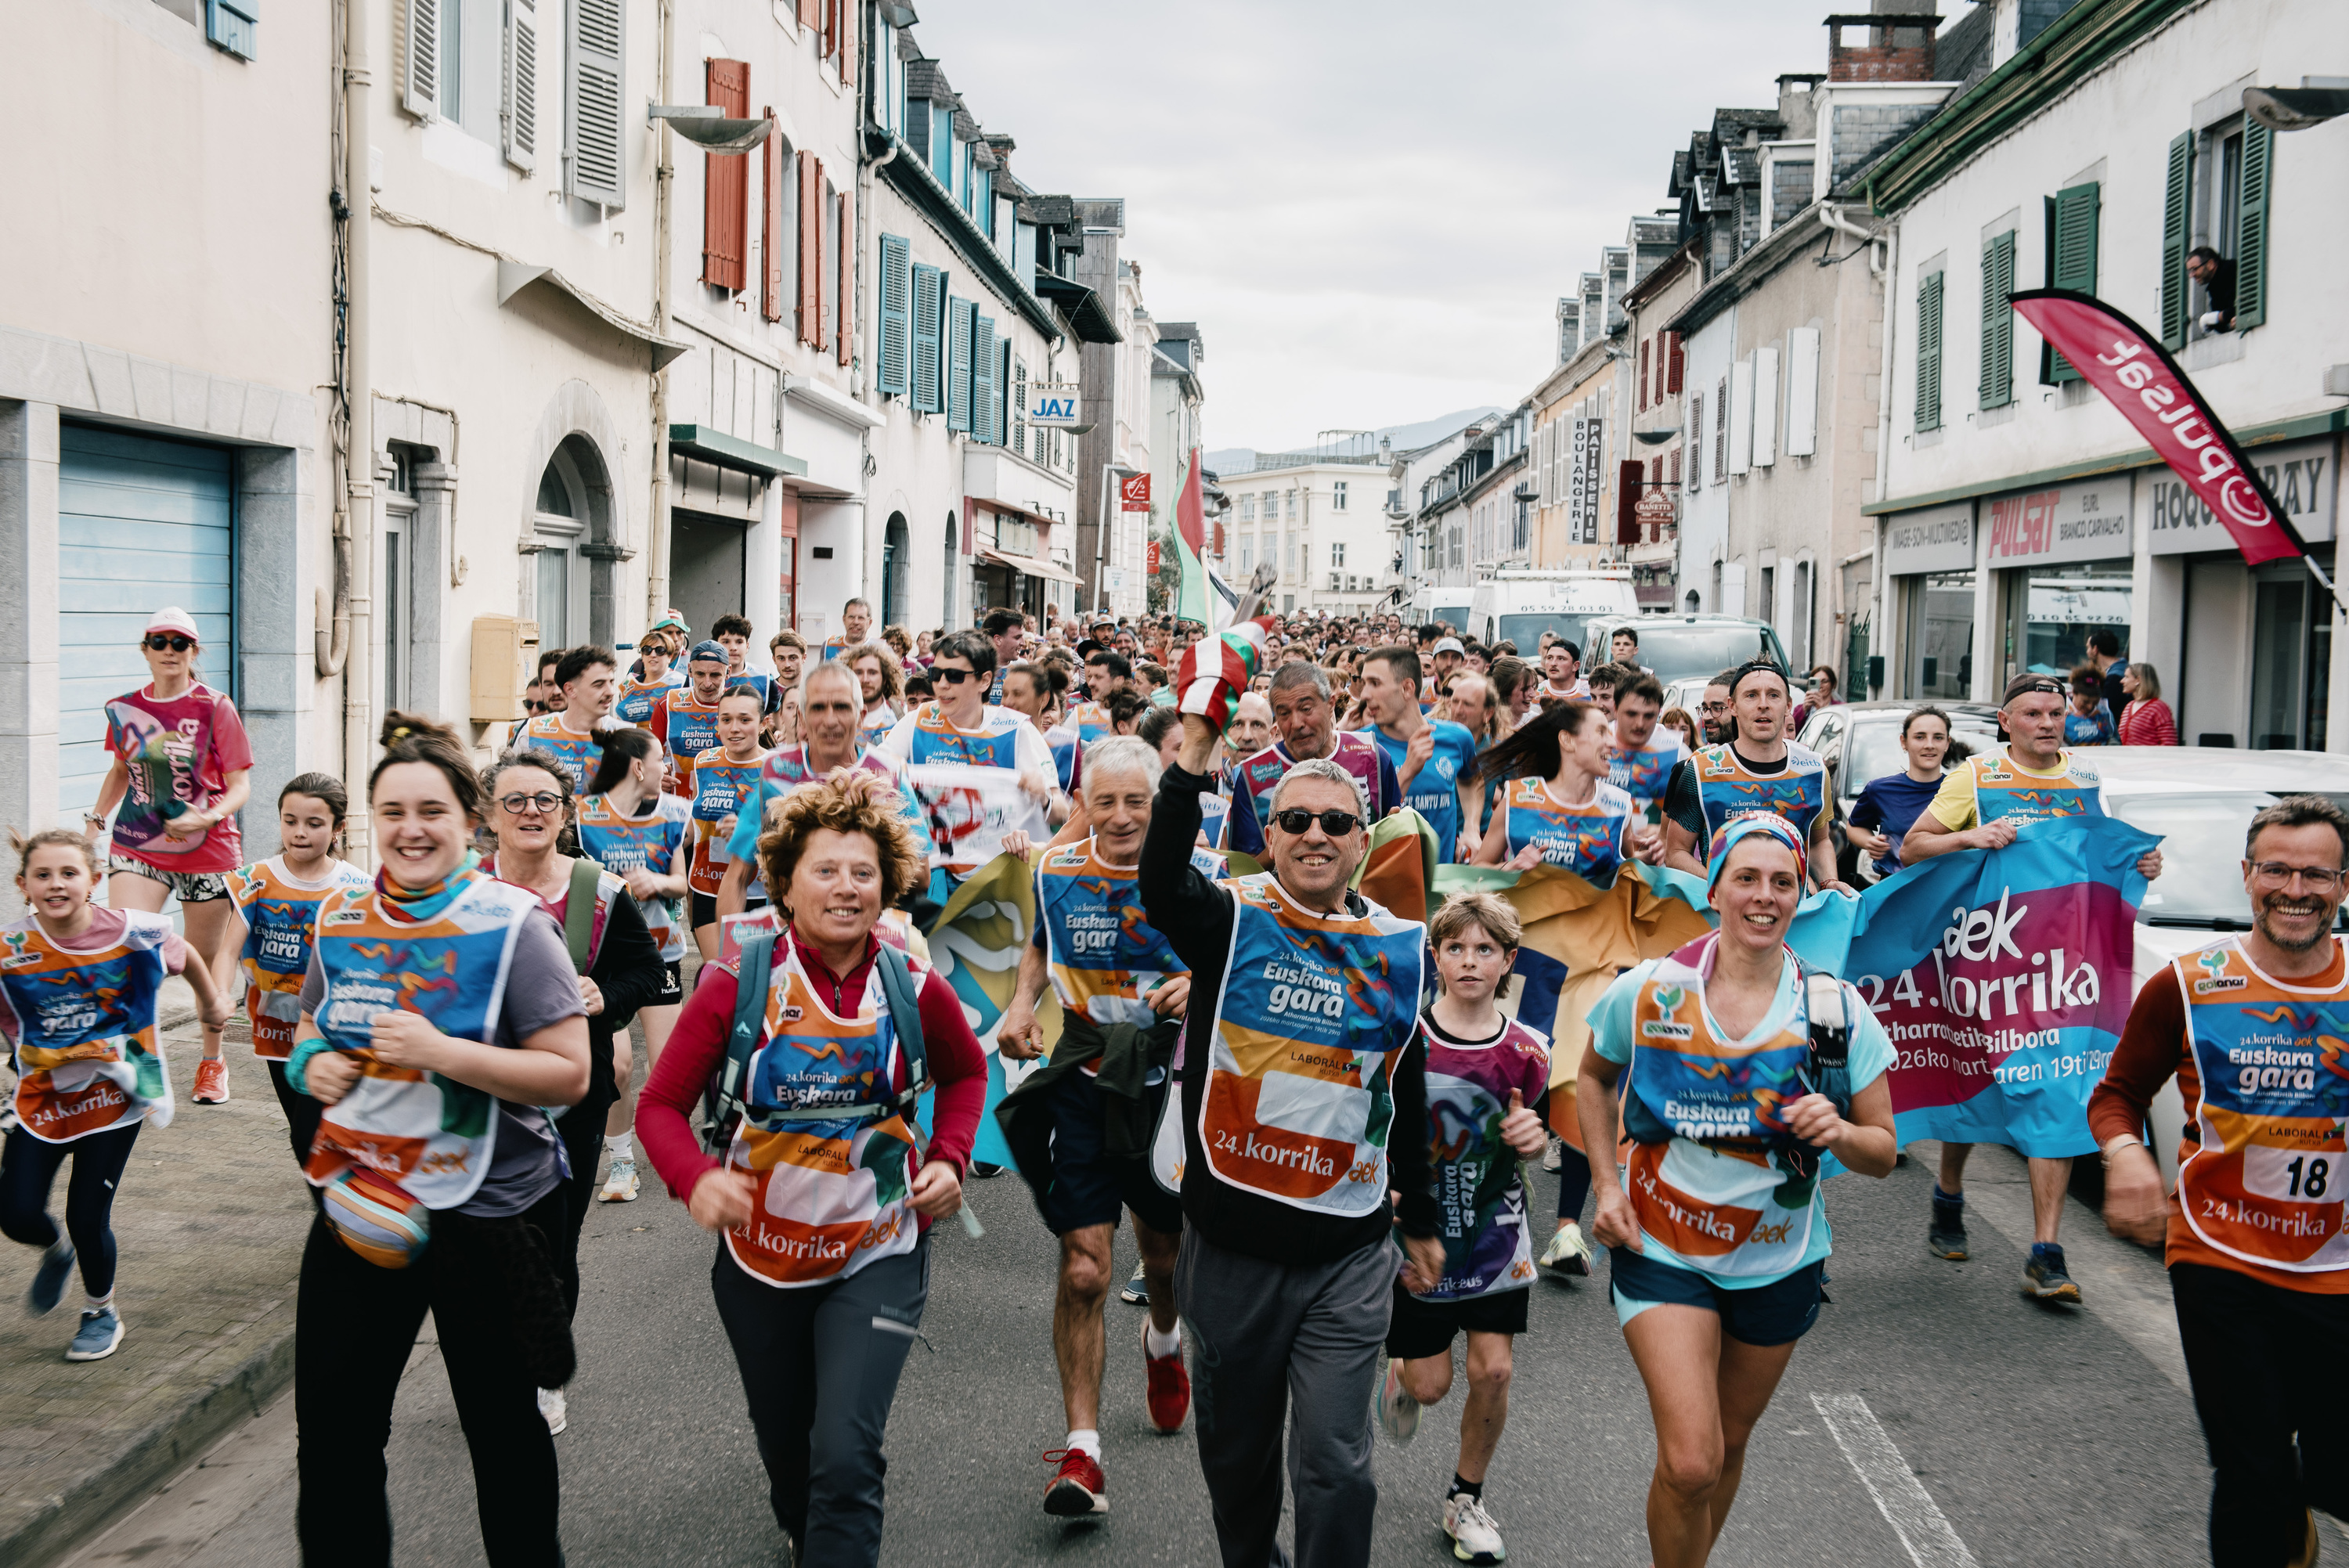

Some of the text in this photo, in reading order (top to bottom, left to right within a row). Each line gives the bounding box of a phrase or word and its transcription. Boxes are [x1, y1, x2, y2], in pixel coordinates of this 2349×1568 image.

[1033, 398, 1074, 416] JAZ
[1572, 420, 1585, 541] BOULANGERIE
[1586, 424, 1600, 539] PATISSERIE
[2083, 494, 2099, 514] EURL
[2060, 516, 2124, 541] BRANCO CARVALHO
[627, 705, 648, 717] gara
[685, 738, 713, 749] gara
[1800, 759, 1820, 767] eitb
[2080, 771, 2098, 781] eitb
[702, 788, 735, 798] Euskara
[1415, 794, 1438, 810] SANTU
[702, 797, 734, 811] gara
[1530, 835, 1576, 852] Euskara
[601, 850, 645, 860] Euskara
[1192, 852, 1213, 867] itb
[141, 925, 162, 939] eitb
[1943, 885, 2028, 962] aek
[254, 925, 301, 944] Euskara
[1263, 961, 1342, 995] Euskara
[1325, 965, 1340, 976] aek
[1856, 948, 2100, 1020] 24.korrika
[1267, 985, 1344, 1018] gara
[41, 1012, 98, 1037] gara
[1259, 1015, 1280, 1025] 2026ko
[1280, 1019, 1313, 1031] martxoaren
[1314, 1026, 1328, 1034] 19tik
[1322, 1018, 1342, 1028] Bilbora
[2240, 1033, 2314, 1047] 24.korrika aek
[1290, 1051, 1340, 1070] LABORAL
[1525, 1045, 1548, 1062] EROSKI
[1886, 1048, 1949, 1072] 026ko
[2229, 1046, 2314, 1067] Euskara
[785, 1070, 837, 1083] 24.korrika
[1319, 1068, 1340, 1078] kutxa
[2239, 1066, 2315, 1095] gara
[777, 1084, 856, 1104] Euskara
[31, 1087, 127, 1127] 24.korrika
[1664, 1099, 1750, 1123] Euskara
[2269, 1127, 2321, 1139] LABORAL
[798, 1144, 843, 1161] LABORAL
[1214, 1129, 1380, 1185] 24.korrika aek
[822, 1159, 843, 1169] kutxa
[2288, 1155, 2329, 1199] 18
[1442, 1165, 1462, 1238] Euskara
[2202, 1199, 2326, 1237] 24.korrika
[732, 1209, 902, 1260] 24.korrika aek
[1751, 1217, 1793, 1245] aek
